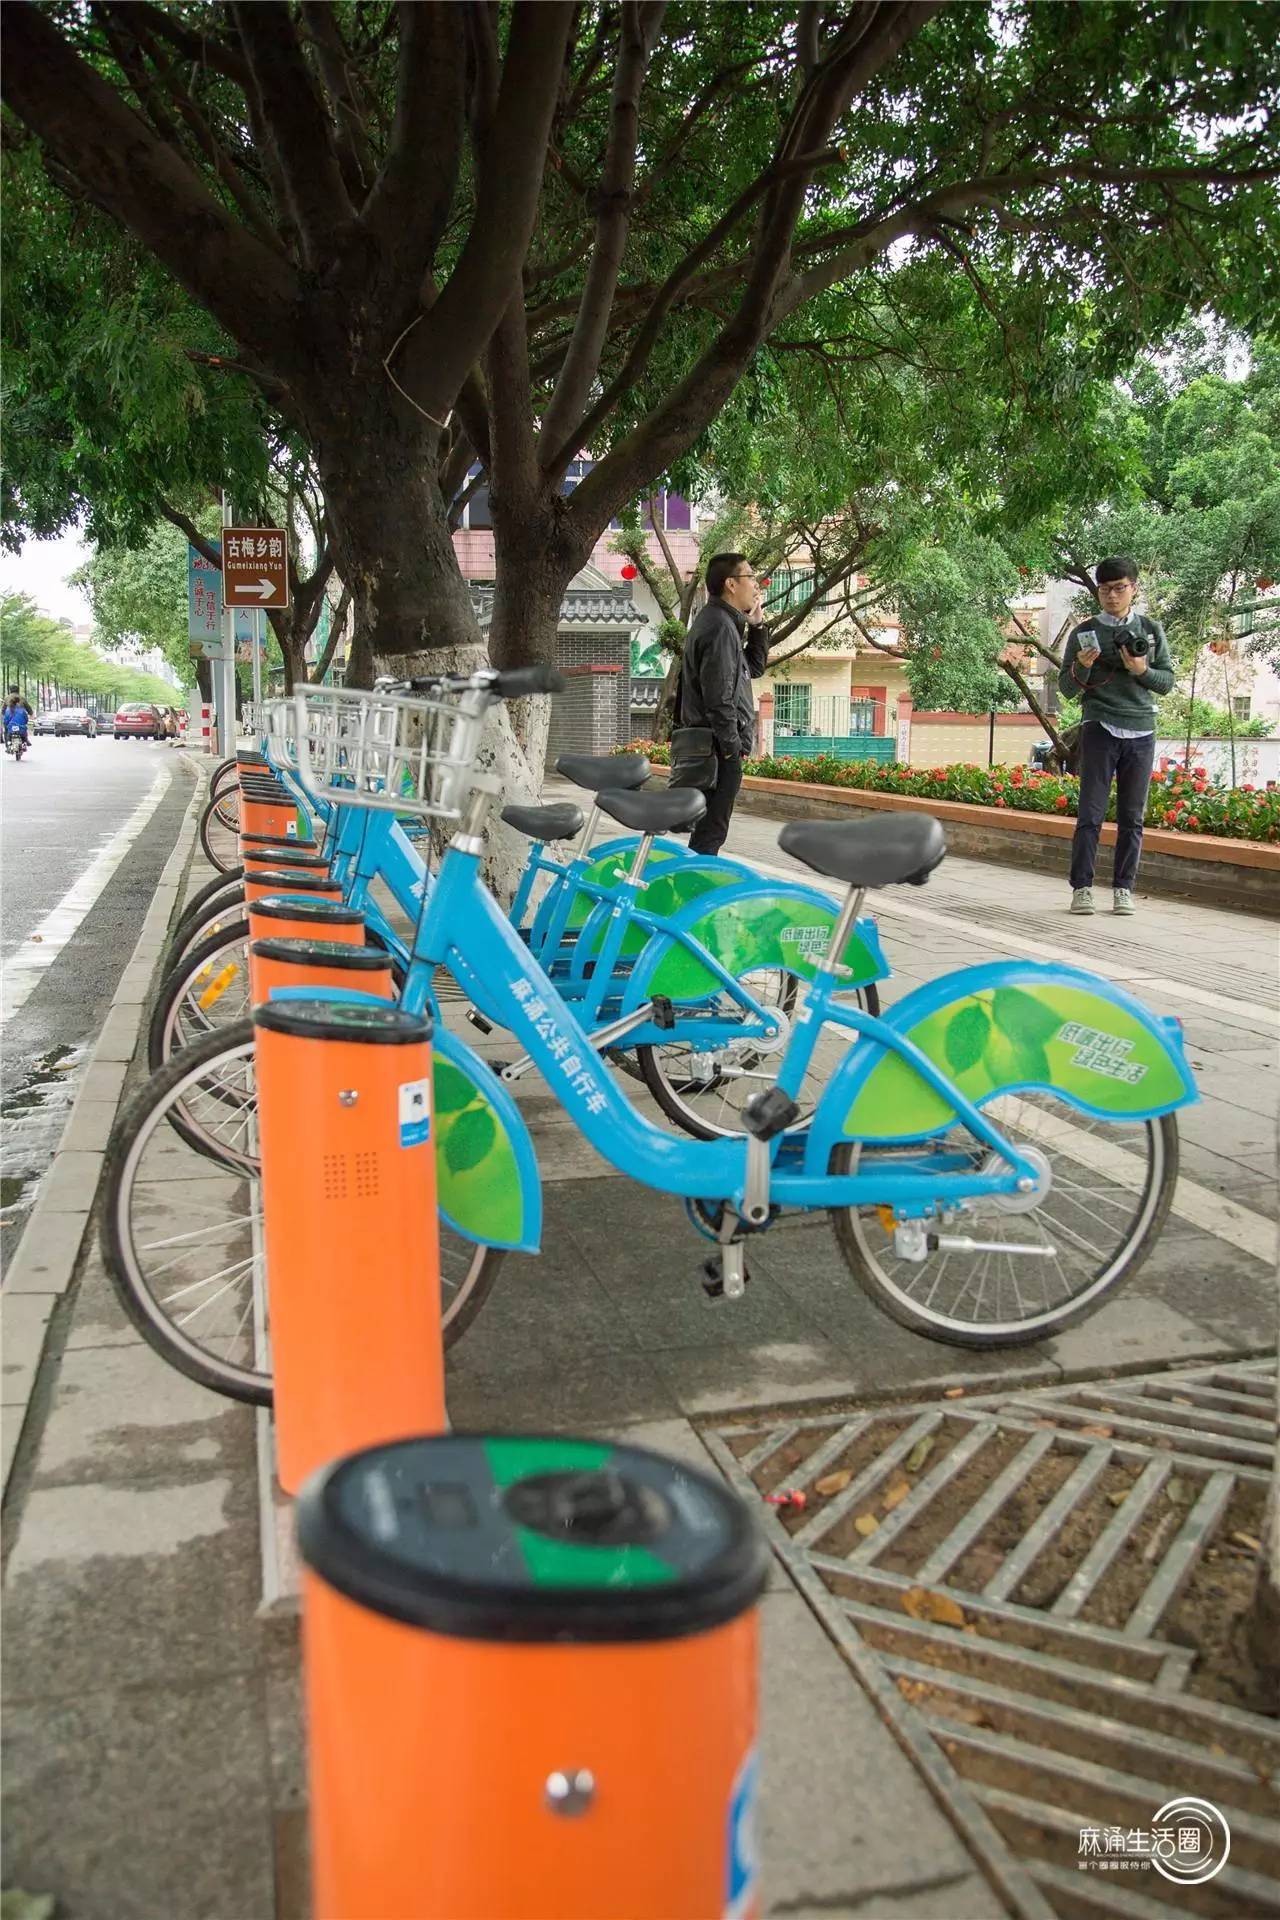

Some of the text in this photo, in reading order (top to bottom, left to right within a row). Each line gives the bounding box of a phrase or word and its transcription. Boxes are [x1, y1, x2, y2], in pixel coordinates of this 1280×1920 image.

[227, 537, 282, 558] 古梅乡韵
[227, 561, 268, 572] Gumeixiang
[269, 561, 283, 570] Yun
[509, 978, 608, 1114] 麻涌公共自行车
[1057, 1021, 1136, 1057] 低碳出行
[1071, 1046, 1149, 1084] 绿色生活
